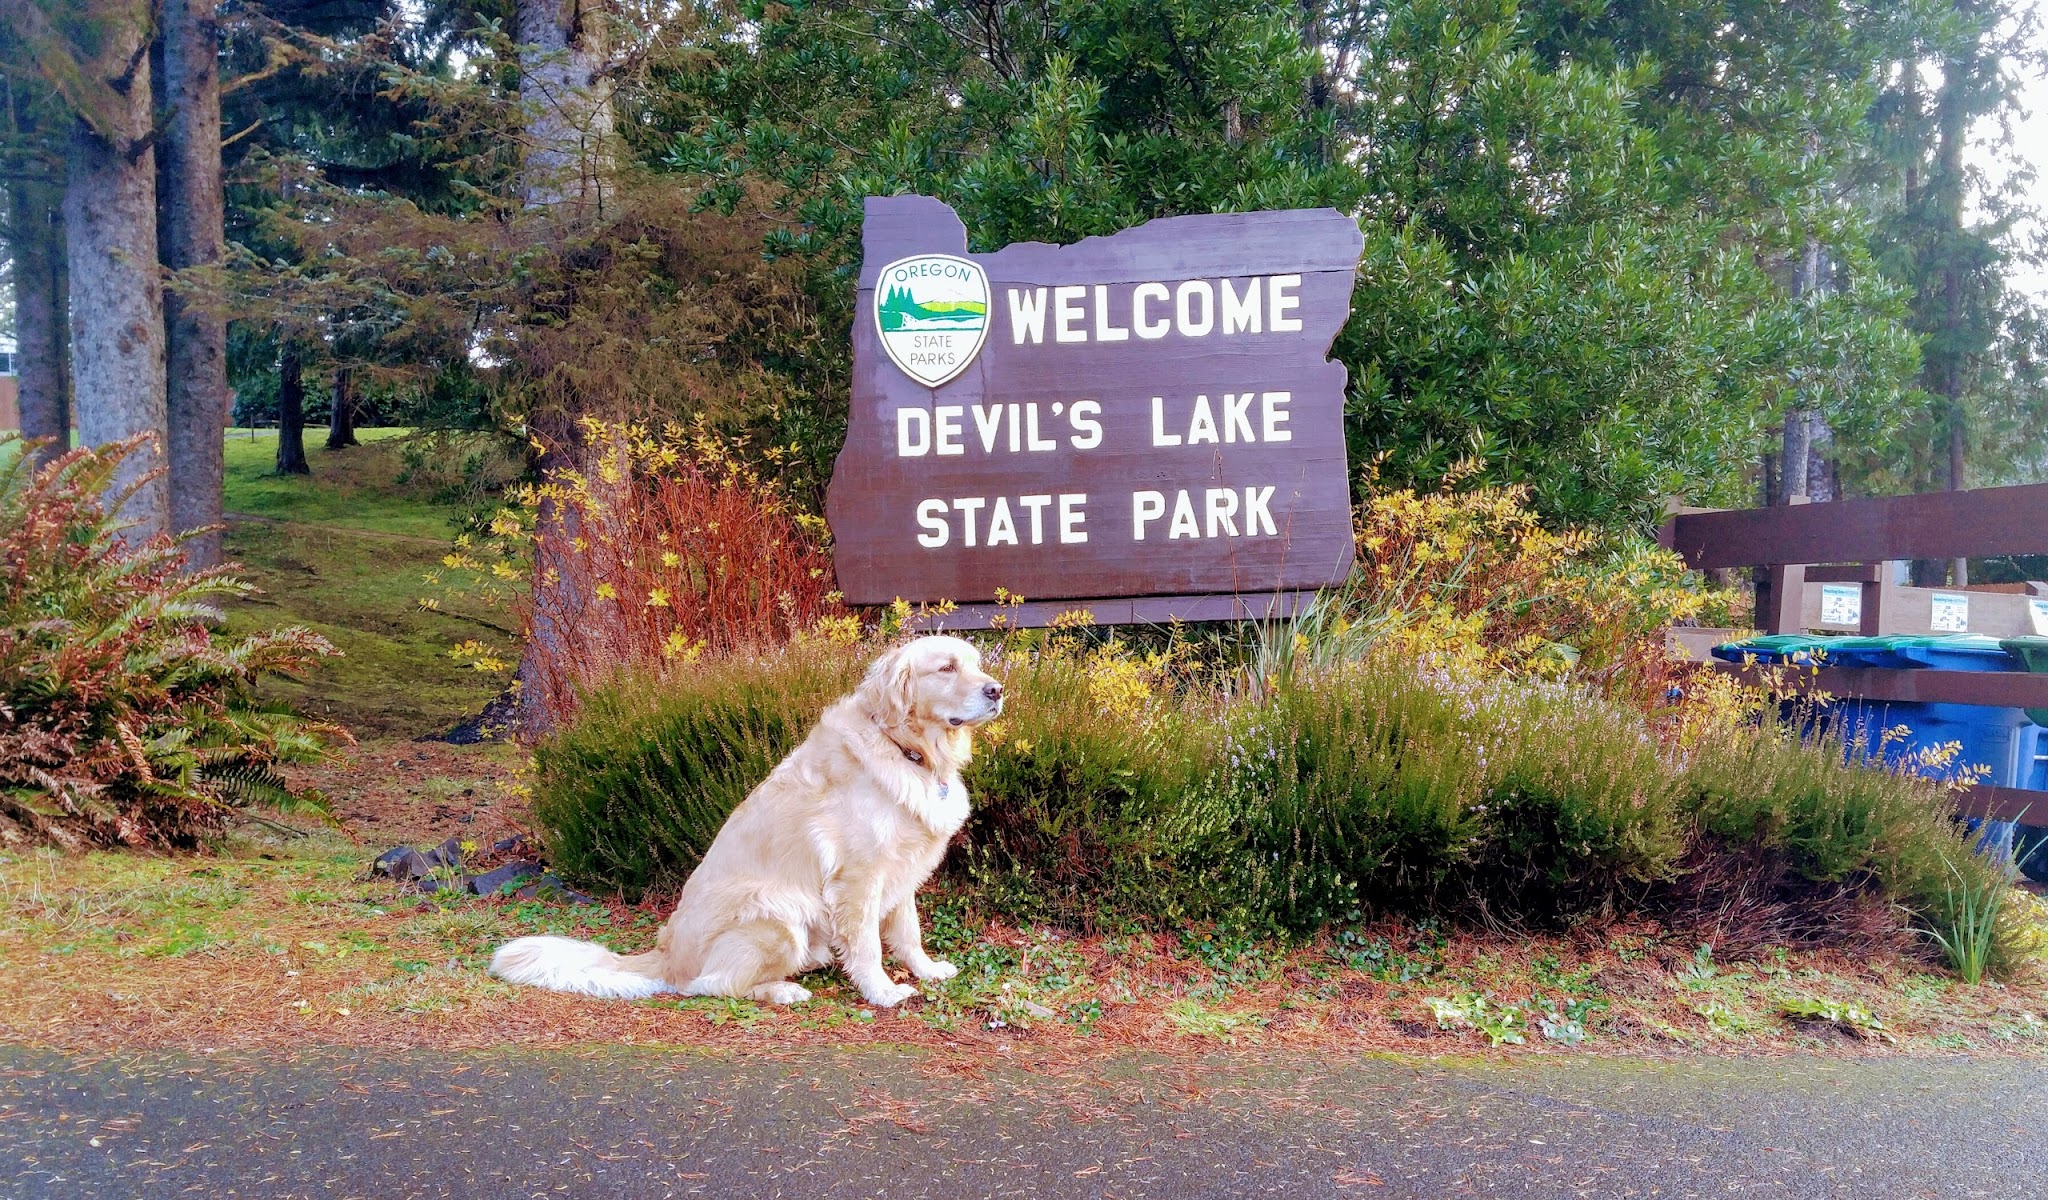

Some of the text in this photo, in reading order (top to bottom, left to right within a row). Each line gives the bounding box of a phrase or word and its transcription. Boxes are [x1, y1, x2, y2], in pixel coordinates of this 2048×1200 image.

[895, 263, 971, 282] OREGON
[1007, 274, 1303, 345] WELCOME
[910, 352, 956, 366] PARKS
[914, 335, 952, 348] STATE
[897, 391, 1292, 457] DEVIL'S LAKE
[916, 485, 1278, 548] STATE PARK
